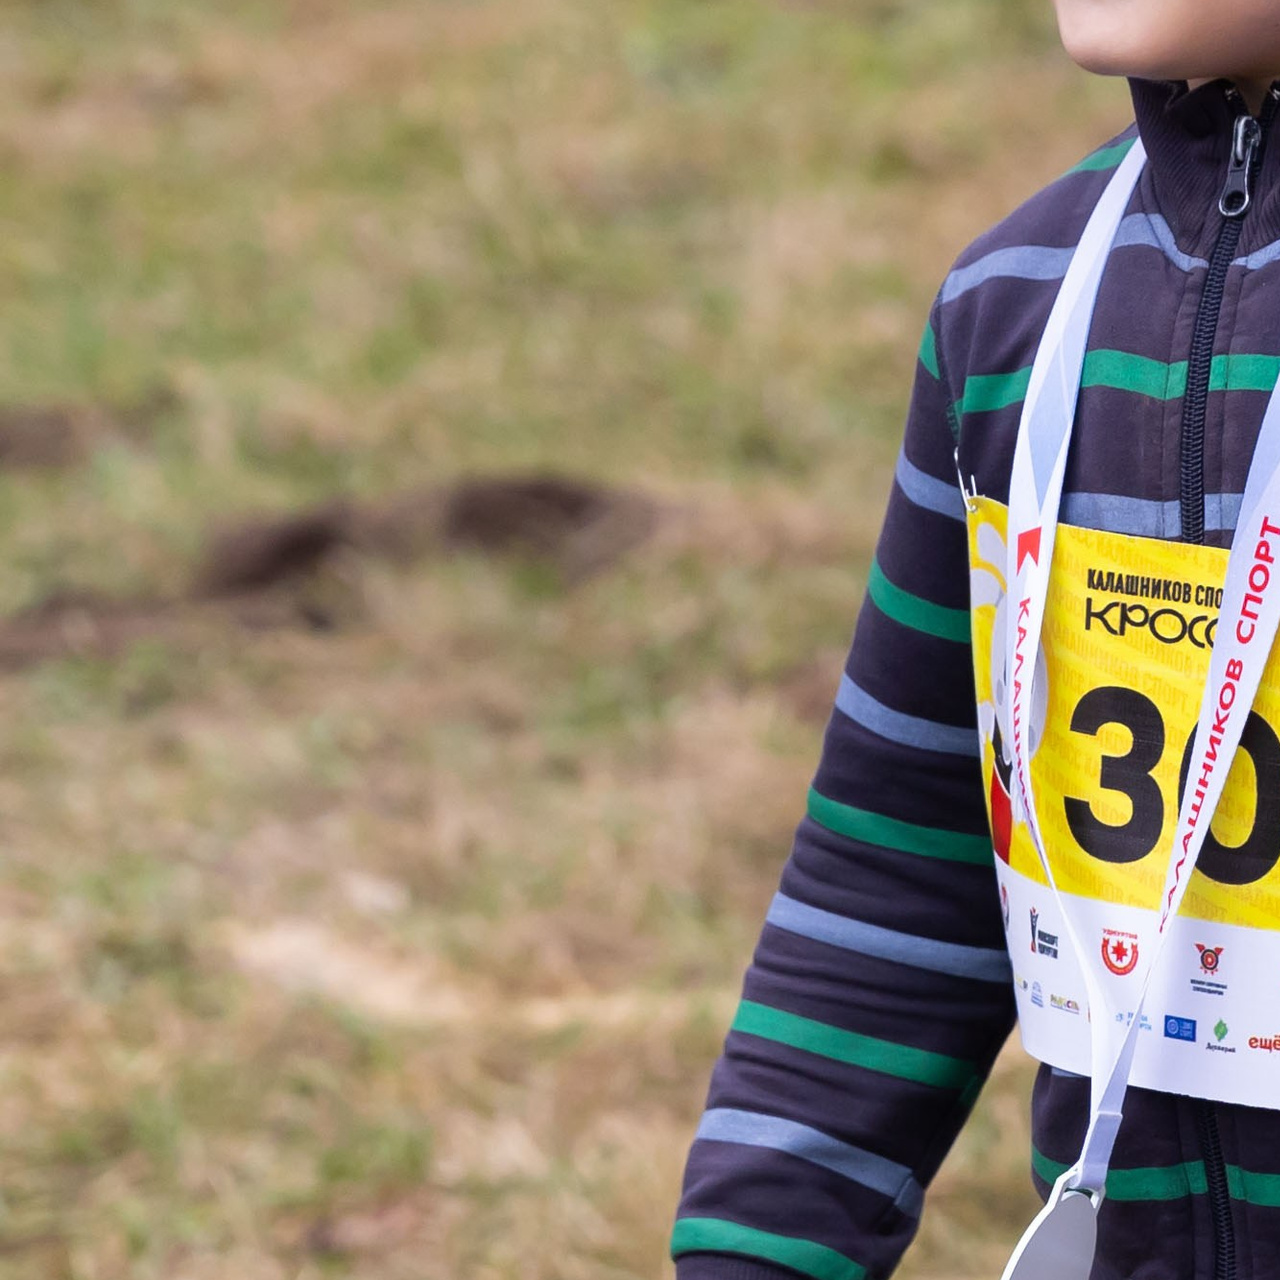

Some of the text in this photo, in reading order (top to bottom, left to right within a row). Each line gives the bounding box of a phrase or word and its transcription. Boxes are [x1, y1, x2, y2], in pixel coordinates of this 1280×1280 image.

[1086, 568, 1224, 609] КАЛАШНИКОВ СПО
[1085, 597, 1219, 649] КРОСС
